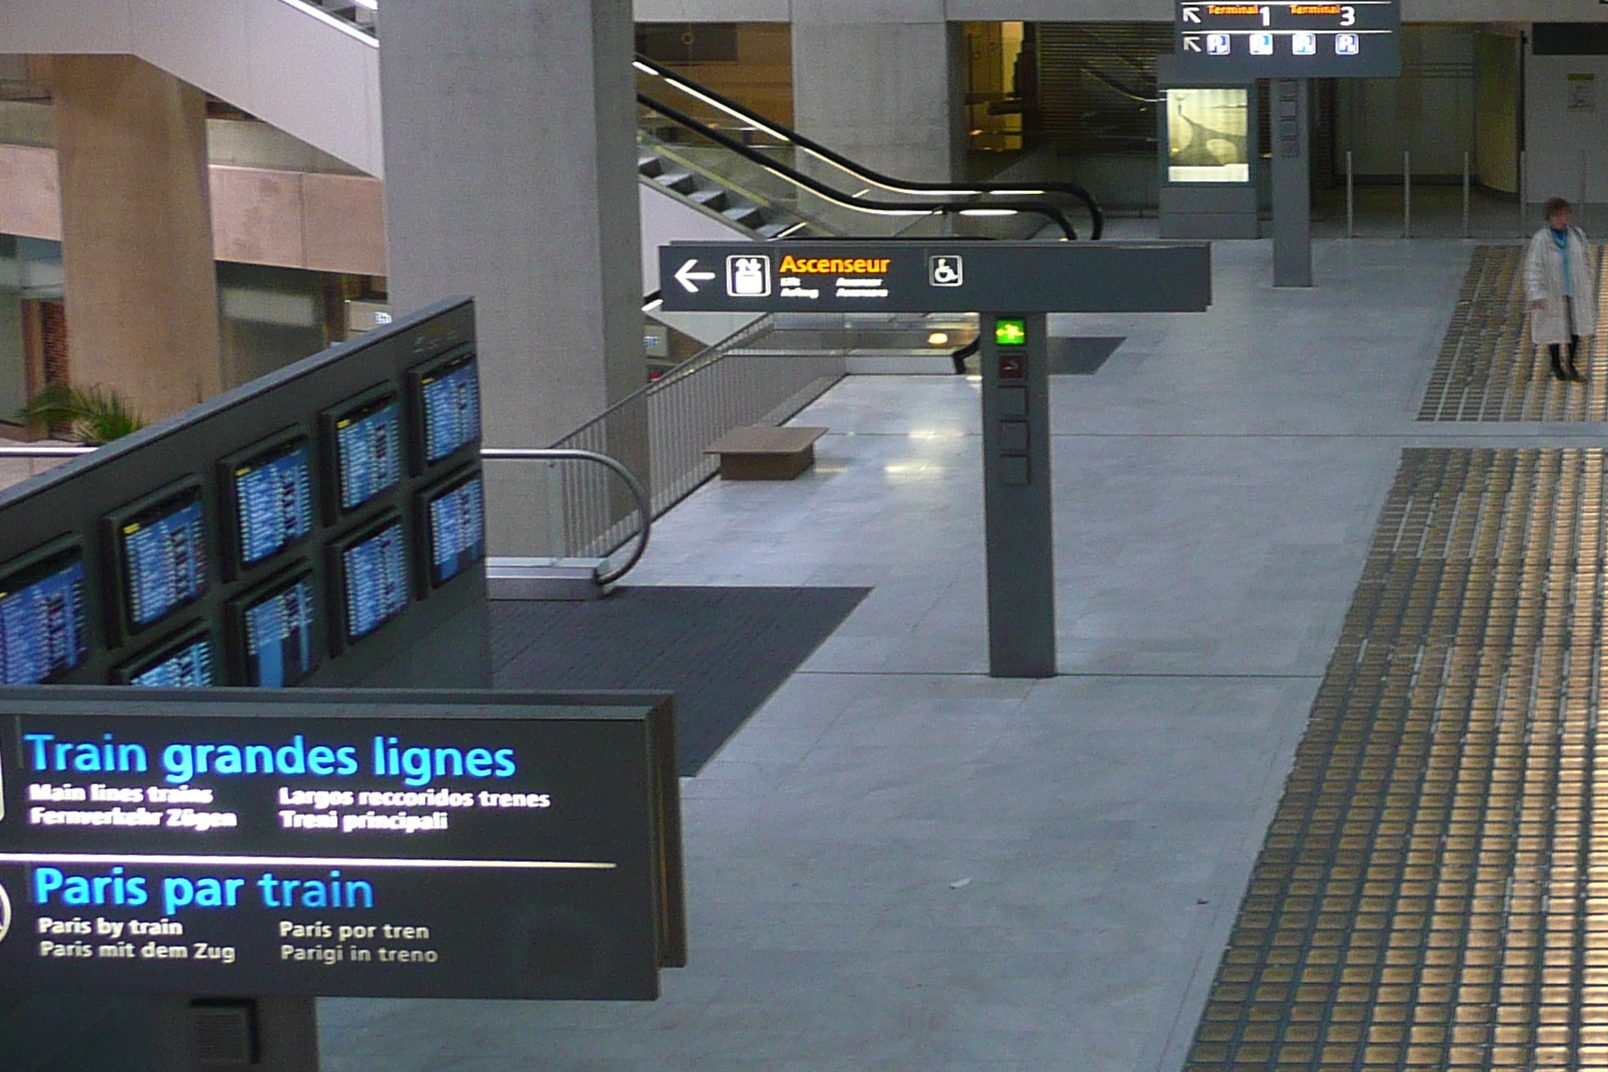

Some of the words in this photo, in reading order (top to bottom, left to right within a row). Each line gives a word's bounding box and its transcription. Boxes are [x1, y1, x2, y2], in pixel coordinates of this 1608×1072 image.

[1208, 5, 1258, 14] Terminal
[1260, 6, 1271, 26] 1
[1290, 5, 1340, 14] Terminal
[1340, 6, 1355, 26] 3
[779, 255, 891, 273] Ascenseur
[23, 734, 148, 771] Train
[163, 735, 358, 783] grandes
[374, 736, 516, 785] lignes
[29, 784, 86, 801] Main
[90, 784, 144, 802] lines
[146, 785, 213, 803] trains
[279, 787, 354, 809] Largos
[358, 788, 474, 807] reccoridos
[478, 790, 550, 807] trenes
[30, 808, 163, 825] Fernverkehr
[166, 808, 237, 830] Zügen
[279, 810, 338, 828] Treni
[343, 811, 448, 832] principali
[35, 866, 148, 905] Paris
[163, 876, 245, 915] par
[257, 870, 374, 907] train
[39, 917, 92, 934] Paris
[97, 917, 124, 938] by
[129, 918, 183, 935] train
[339, 925, 376, 941] por
[383, 923, 429, 939] tren
[40, 941, 93, 957] Paris
[100, 942, 135, 958] mit
[141, 942, 188, 958] dem
[193, 943, 235, 963] Zug
[281, 944, 343, 965] Parigi
[350, 945, 371, 961] in
[378, 947, 438, 962] treno
